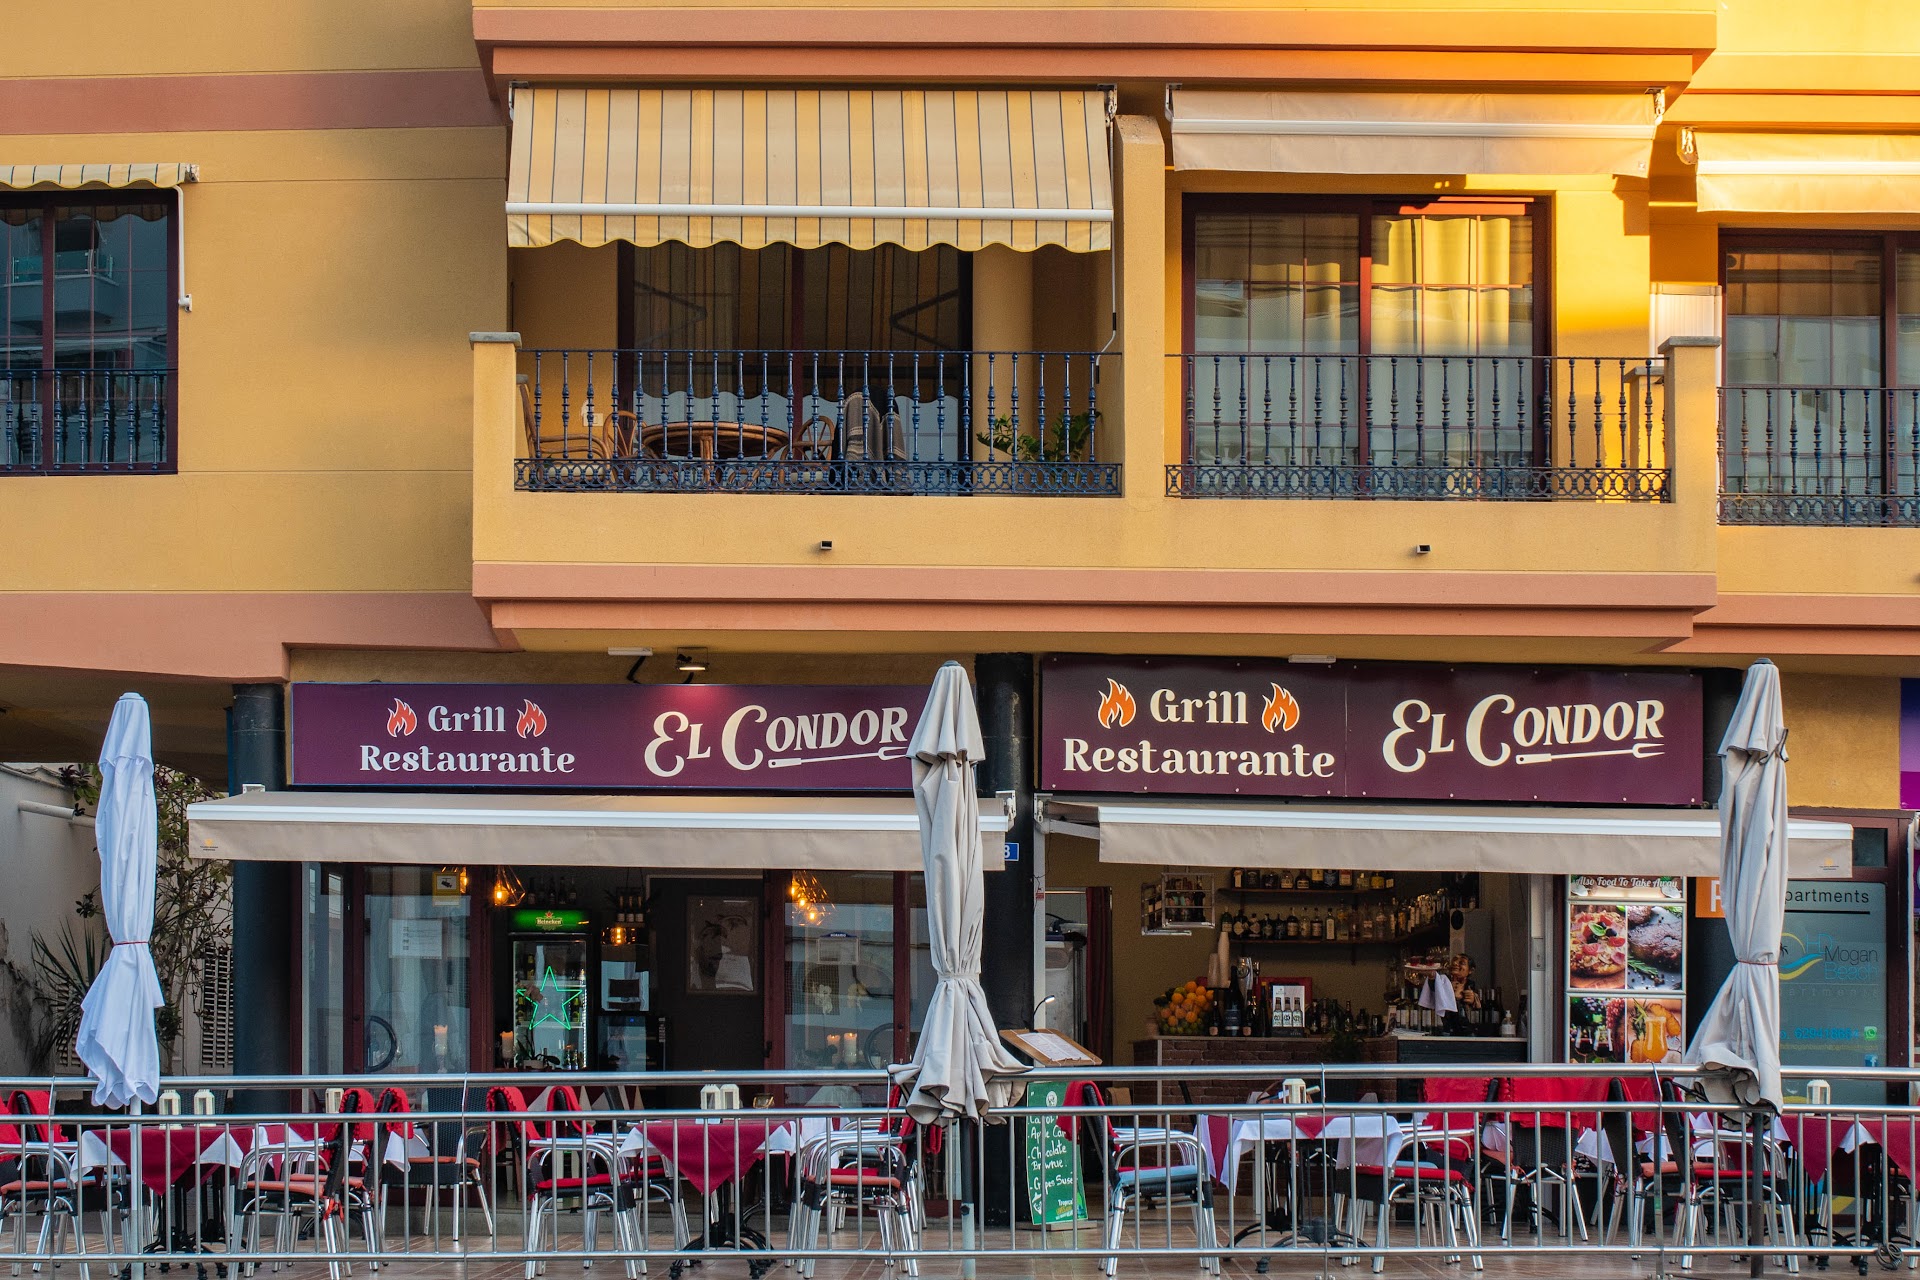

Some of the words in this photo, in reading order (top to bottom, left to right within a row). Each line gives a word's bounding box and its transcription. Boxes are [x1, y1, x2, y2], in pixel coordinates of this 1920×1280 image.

[1150, 688, 1248, 724] Grill
[427, 705, 506, 732] Grill
[359, 744, 575, 773] Restaurante
[1062, 738, 1335, 778] Restaurante
[1576, 875, 1595, 886] Also
[1597, 876, 1617, 887] Food
[1619, 876, 1629, 887] To
[1630, 877, 1651, 888] Take
[1652, 877, 1678, 889] Away
[1785, 889, 1869, 904] partments
[1825, 945, 1879, 966] Mogan
[1825, 962, 1879, 980] Beach
[1030, 1140, 1067, 1160] Chcolate
